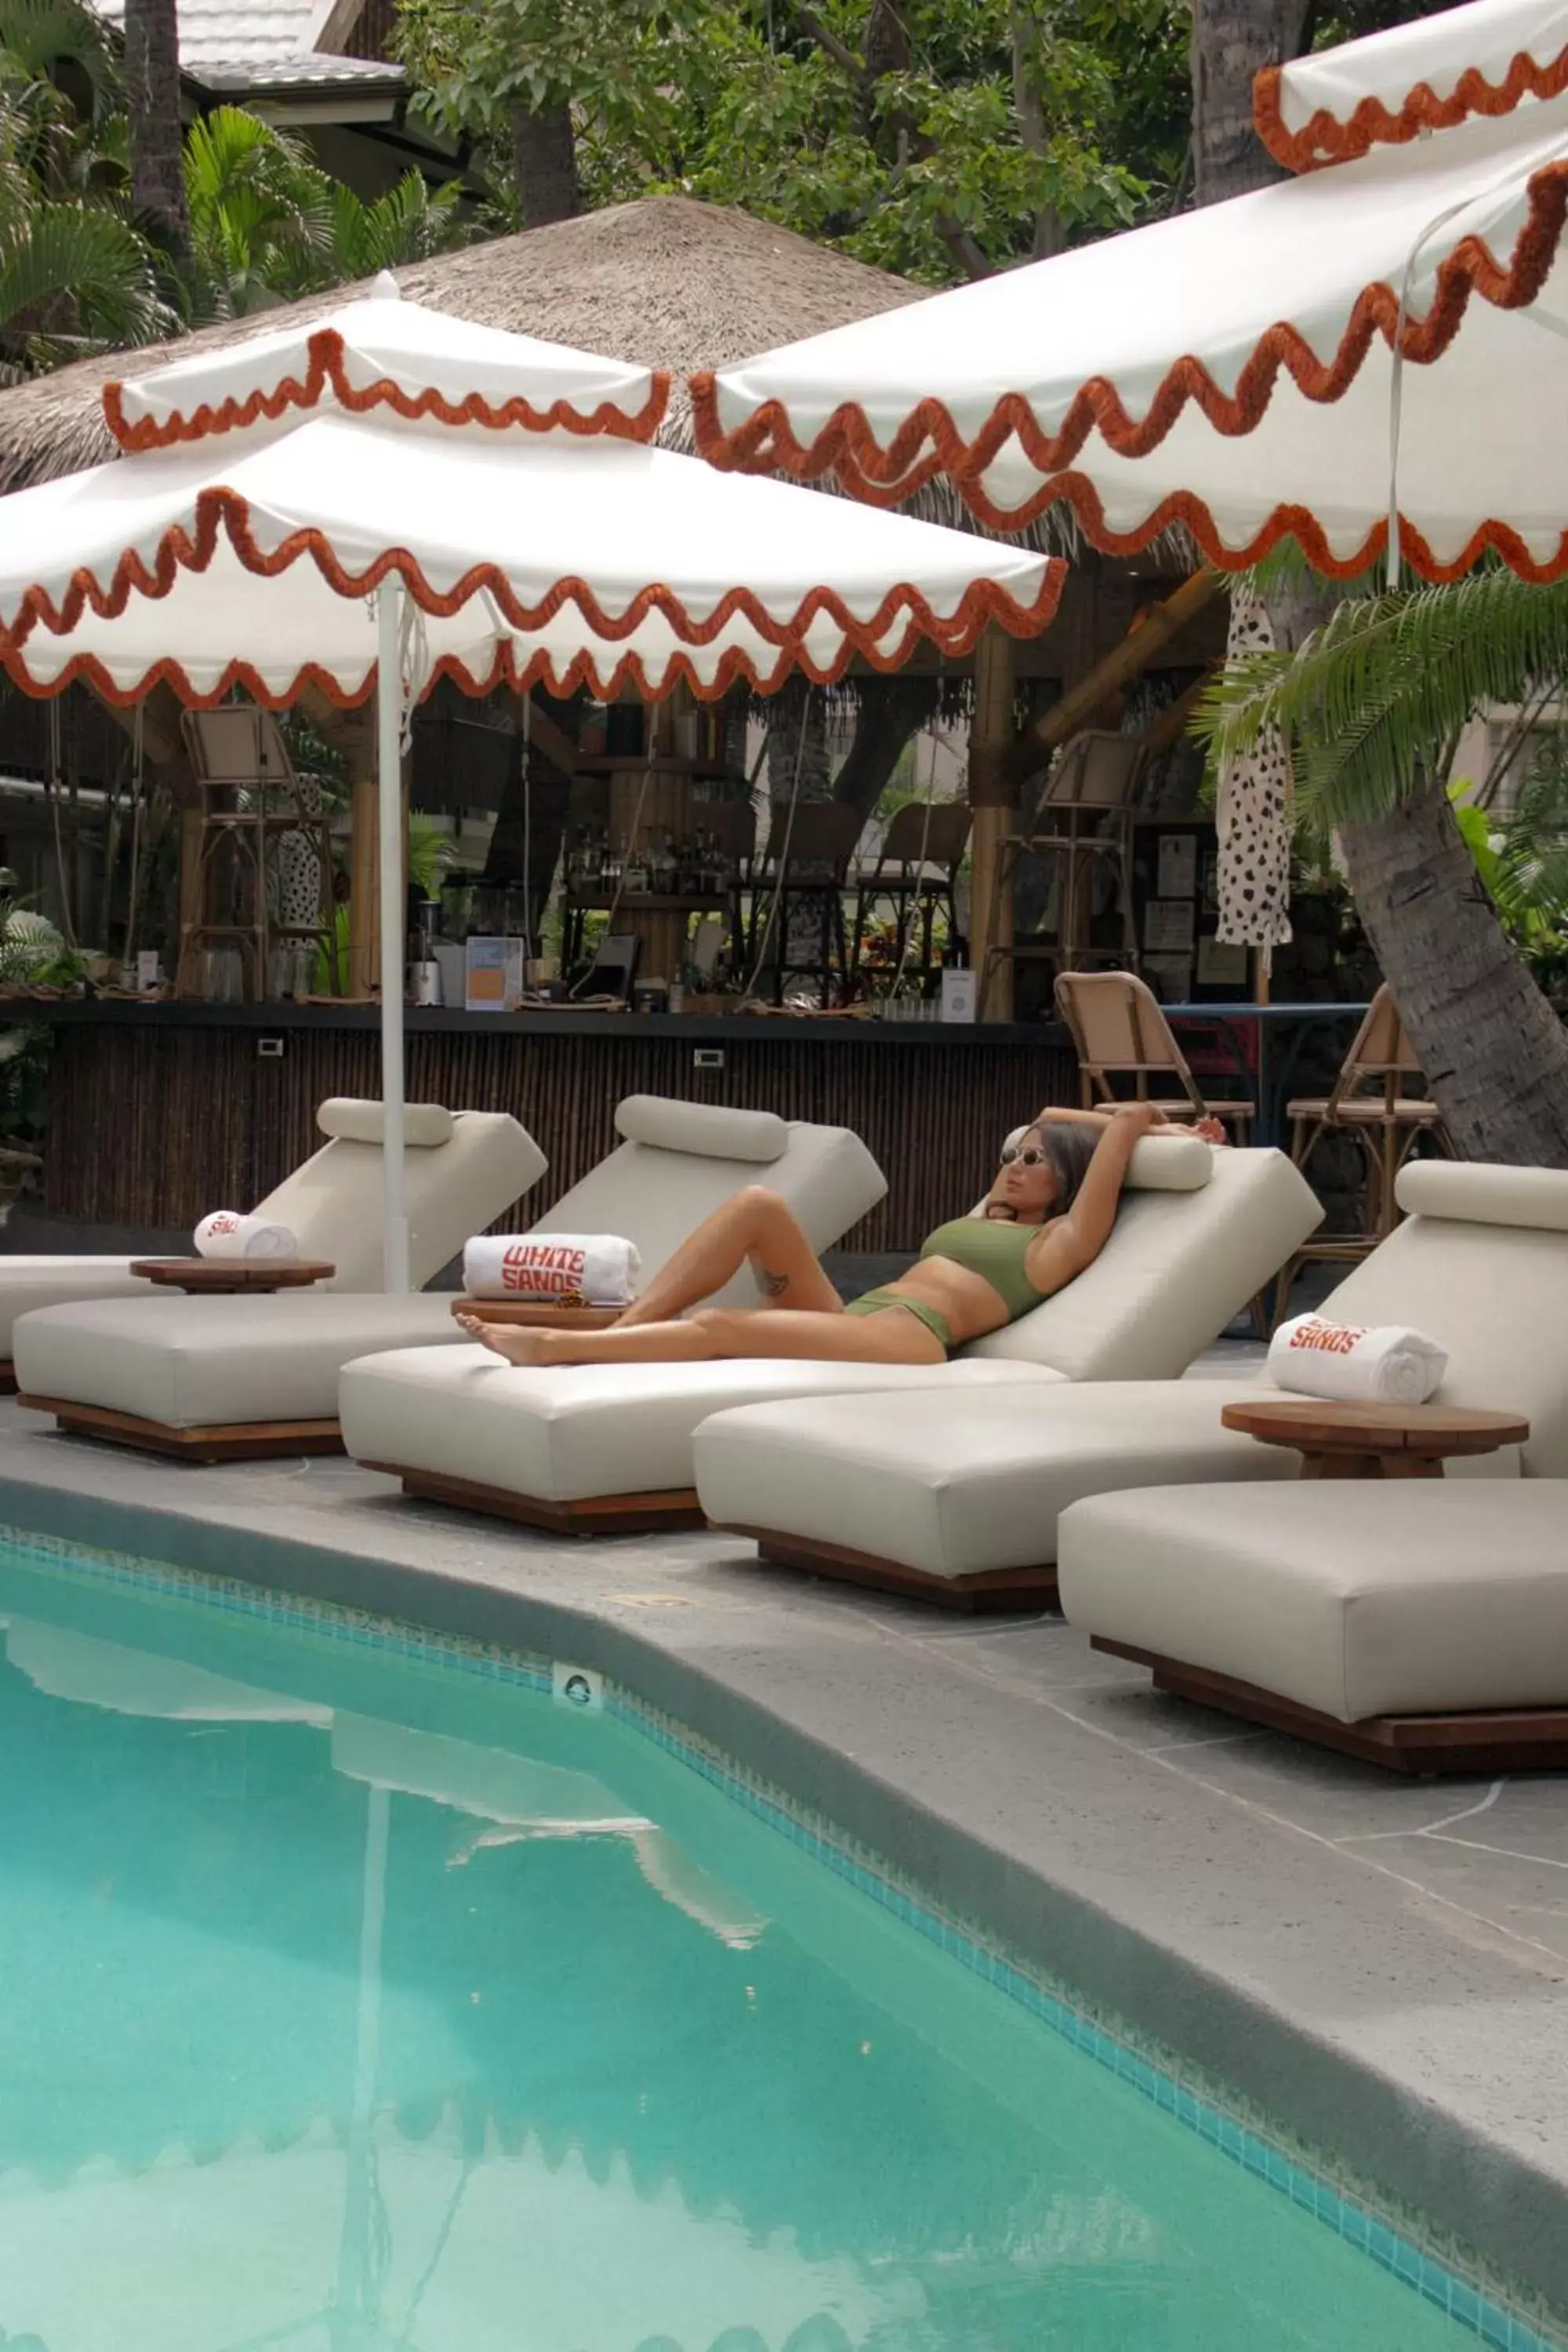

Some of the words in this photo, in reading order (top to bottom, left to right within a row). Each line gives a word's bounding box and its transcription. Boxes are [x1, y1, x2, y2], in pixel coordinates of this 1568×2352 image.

[503, 1245, 586, 1274] WHITE
[502, 1268, 583, 1294] SANDS
[1290, 1326, 1362, 1355] SANDS
